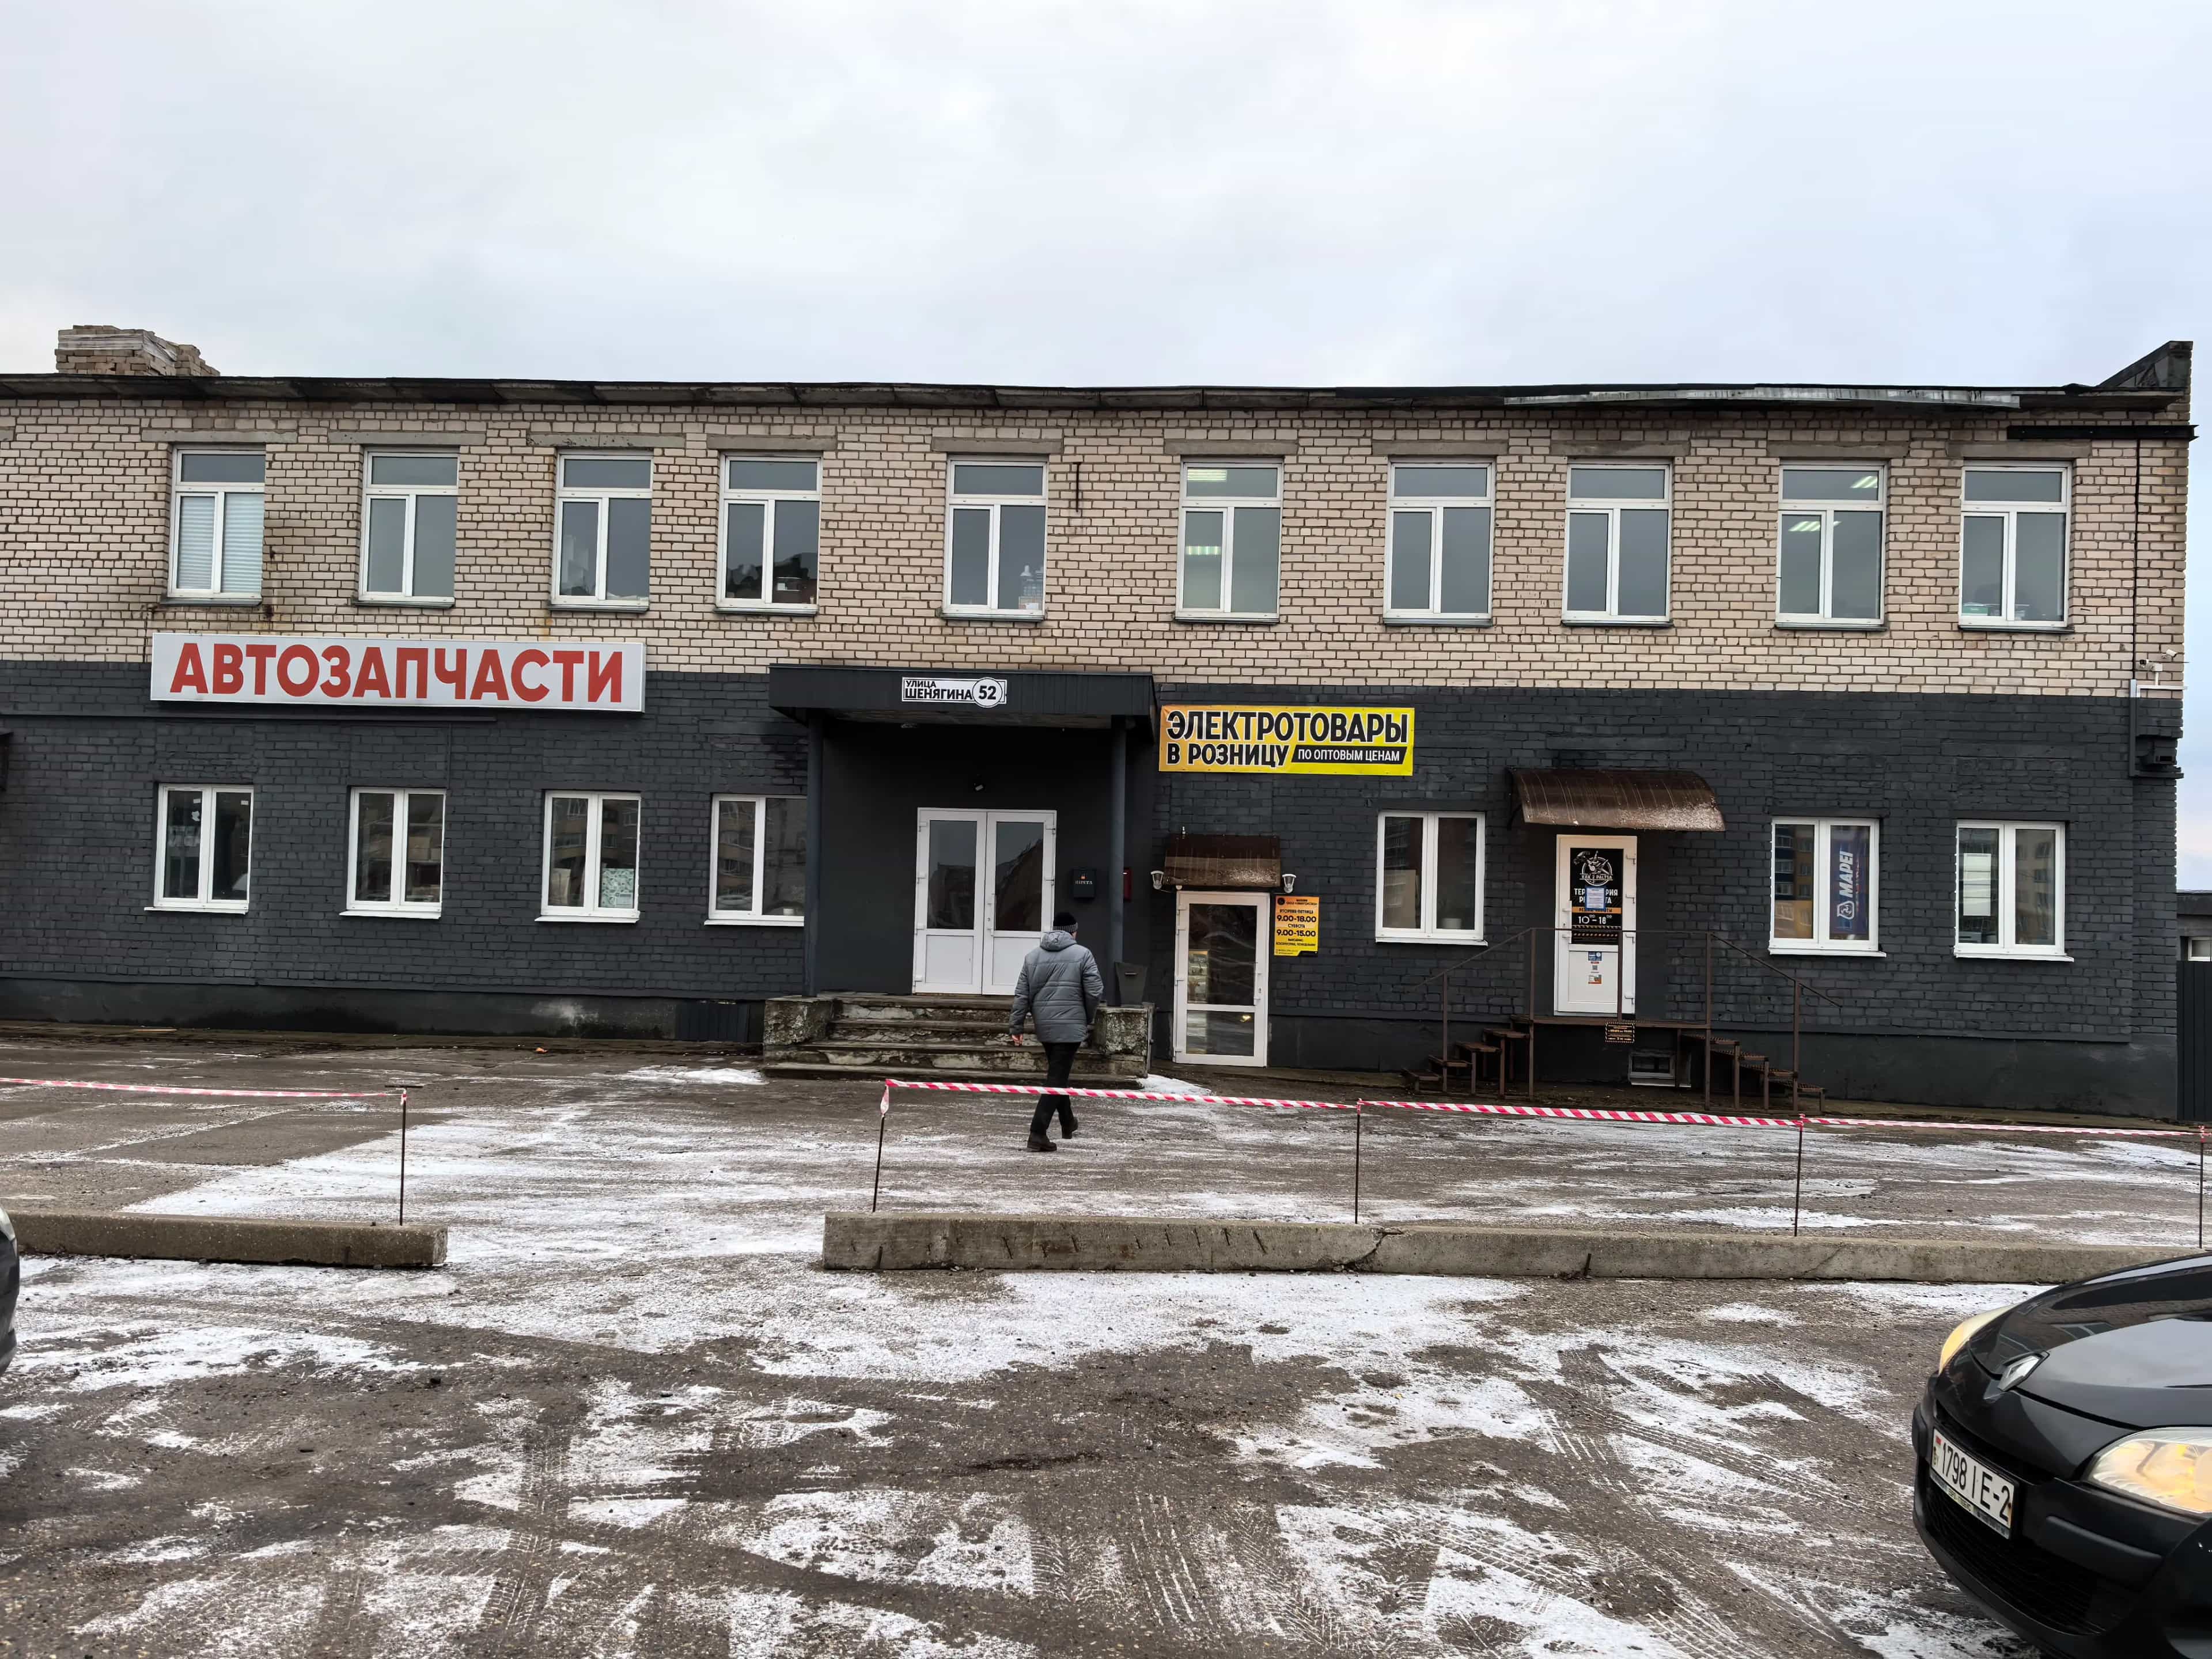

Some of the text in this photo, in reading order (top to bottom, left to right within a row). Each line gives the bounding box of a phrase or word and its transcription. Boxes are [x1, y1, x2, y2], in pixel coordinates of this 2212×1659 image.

[170, 642, 622, 703] АВТОЗАПЧАСТИ
[906, 680, 937, 688] УЛИЦА
[905, 688, 973, 700] ШЕНЯГИНА
[978, 685, 997, 700] 52
[1166, 711, 1408, 743] ЭЛЕКТРОТОВАРЫ
[1166, 743, 1289, 768] В РОЗНИЦУ
[1298, 748, 1400, 763] ПО ОПТОВЫМ ЦЕНАМ
[1839, 851, 1853, 898] MAPEI
[1942, 1442, 1968, 1491] 1798
